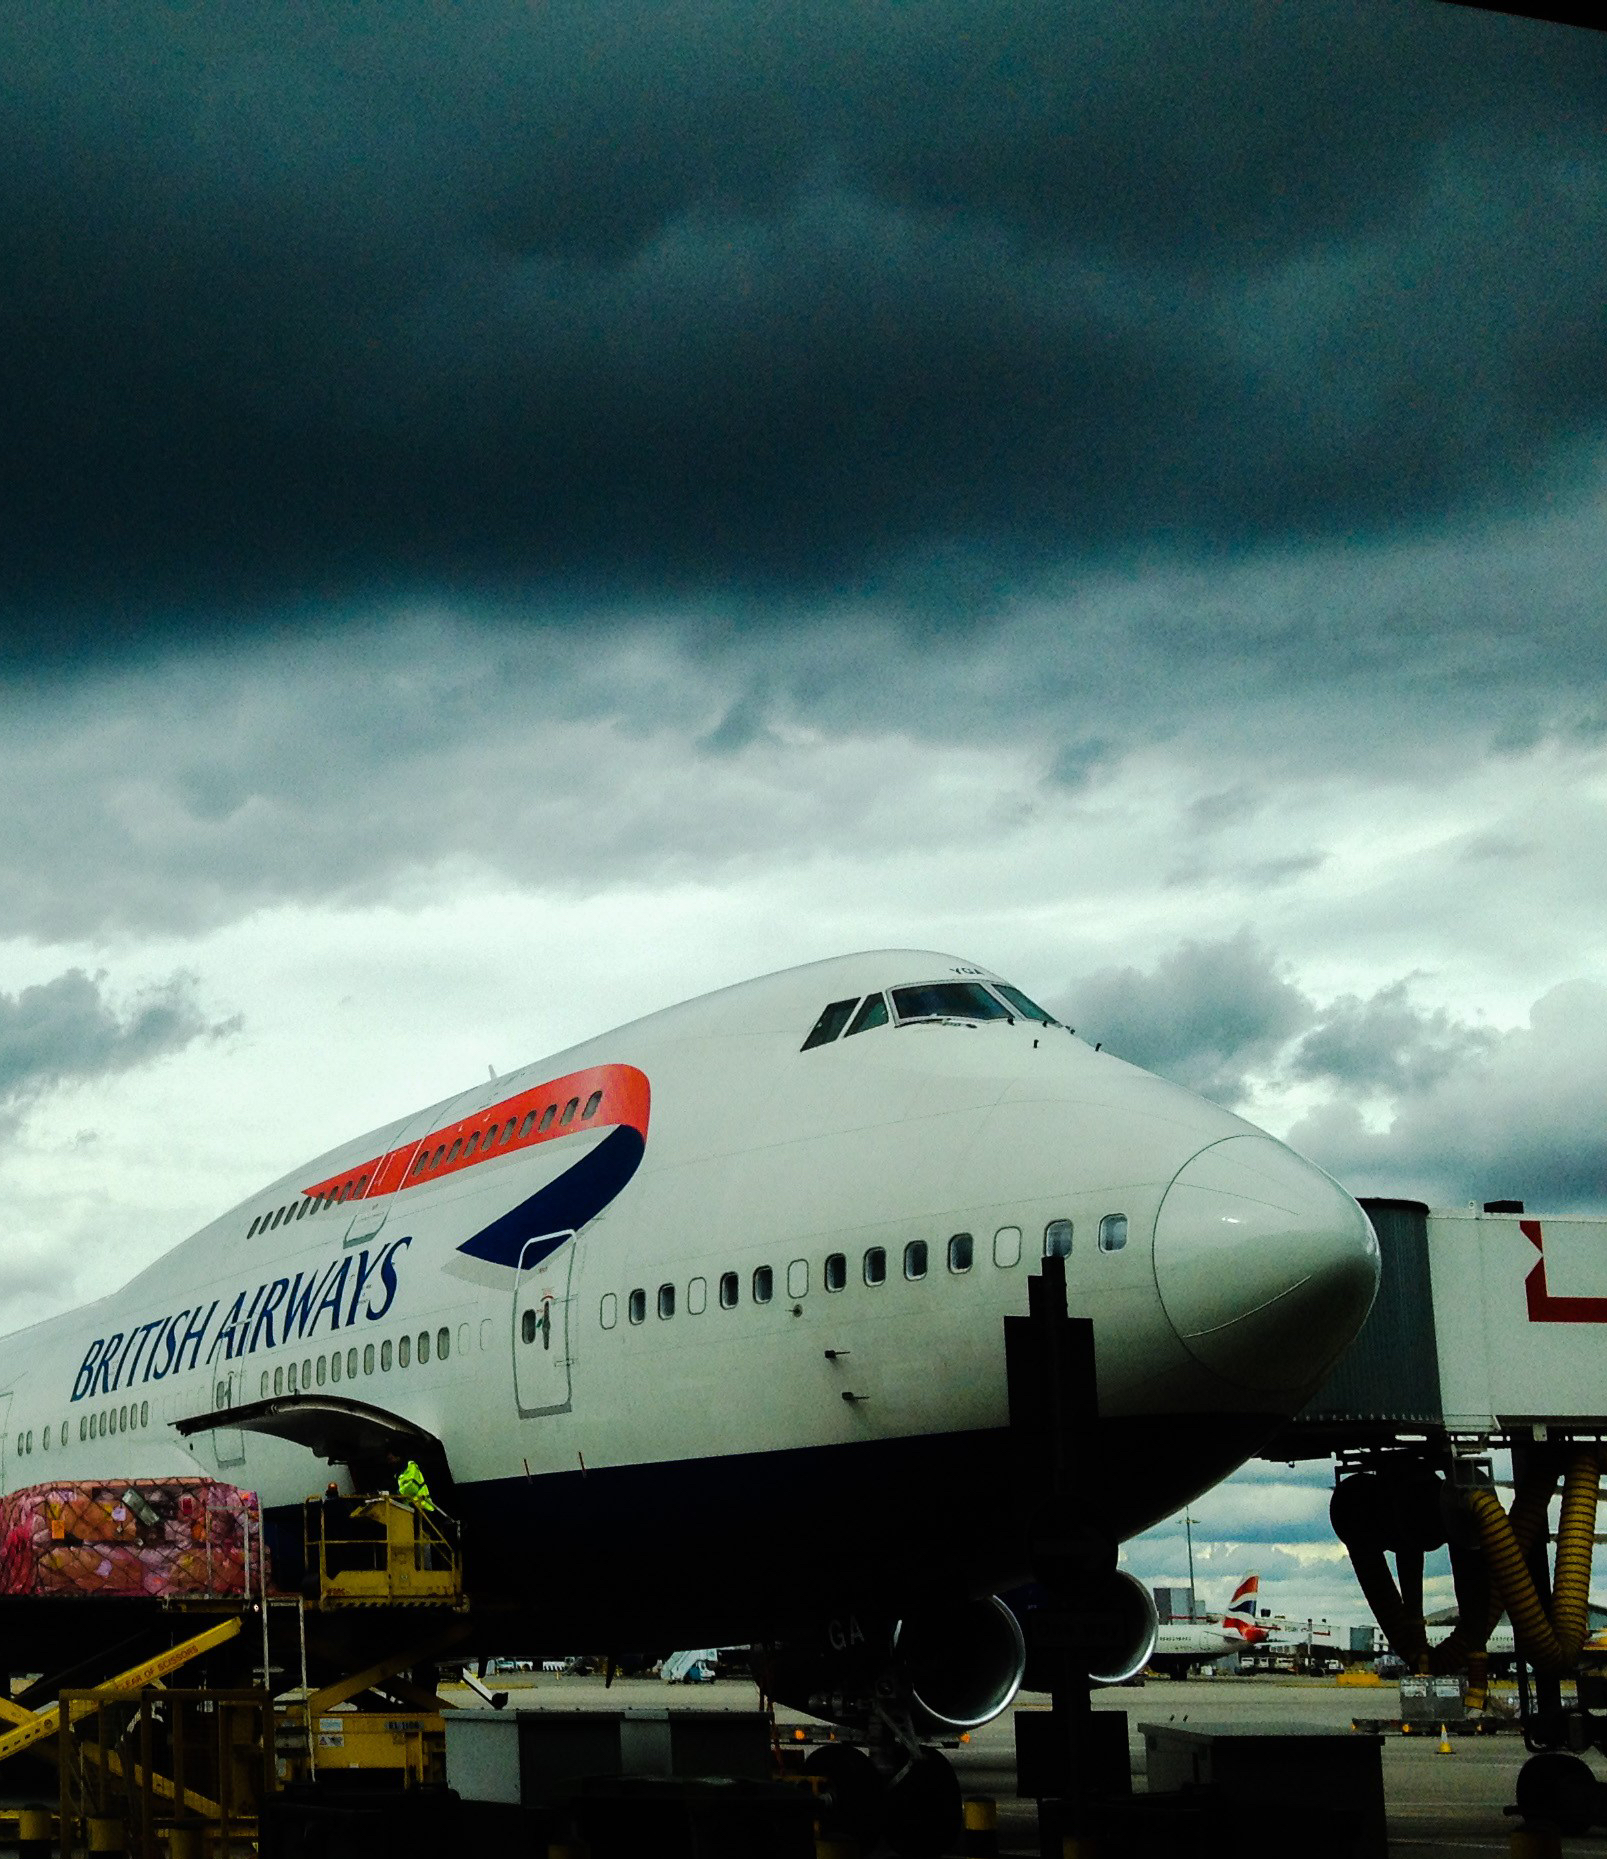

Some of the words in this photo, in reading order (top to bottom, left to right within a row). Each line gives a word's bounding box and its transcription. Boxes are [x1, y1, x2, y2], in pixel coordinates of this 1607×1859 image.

[70, 1299, 221, 1403] BRITISH
[206, 1236, 413, 1366] AIRWAYS
[157, 1644, 199, 1672] SCISSORS
